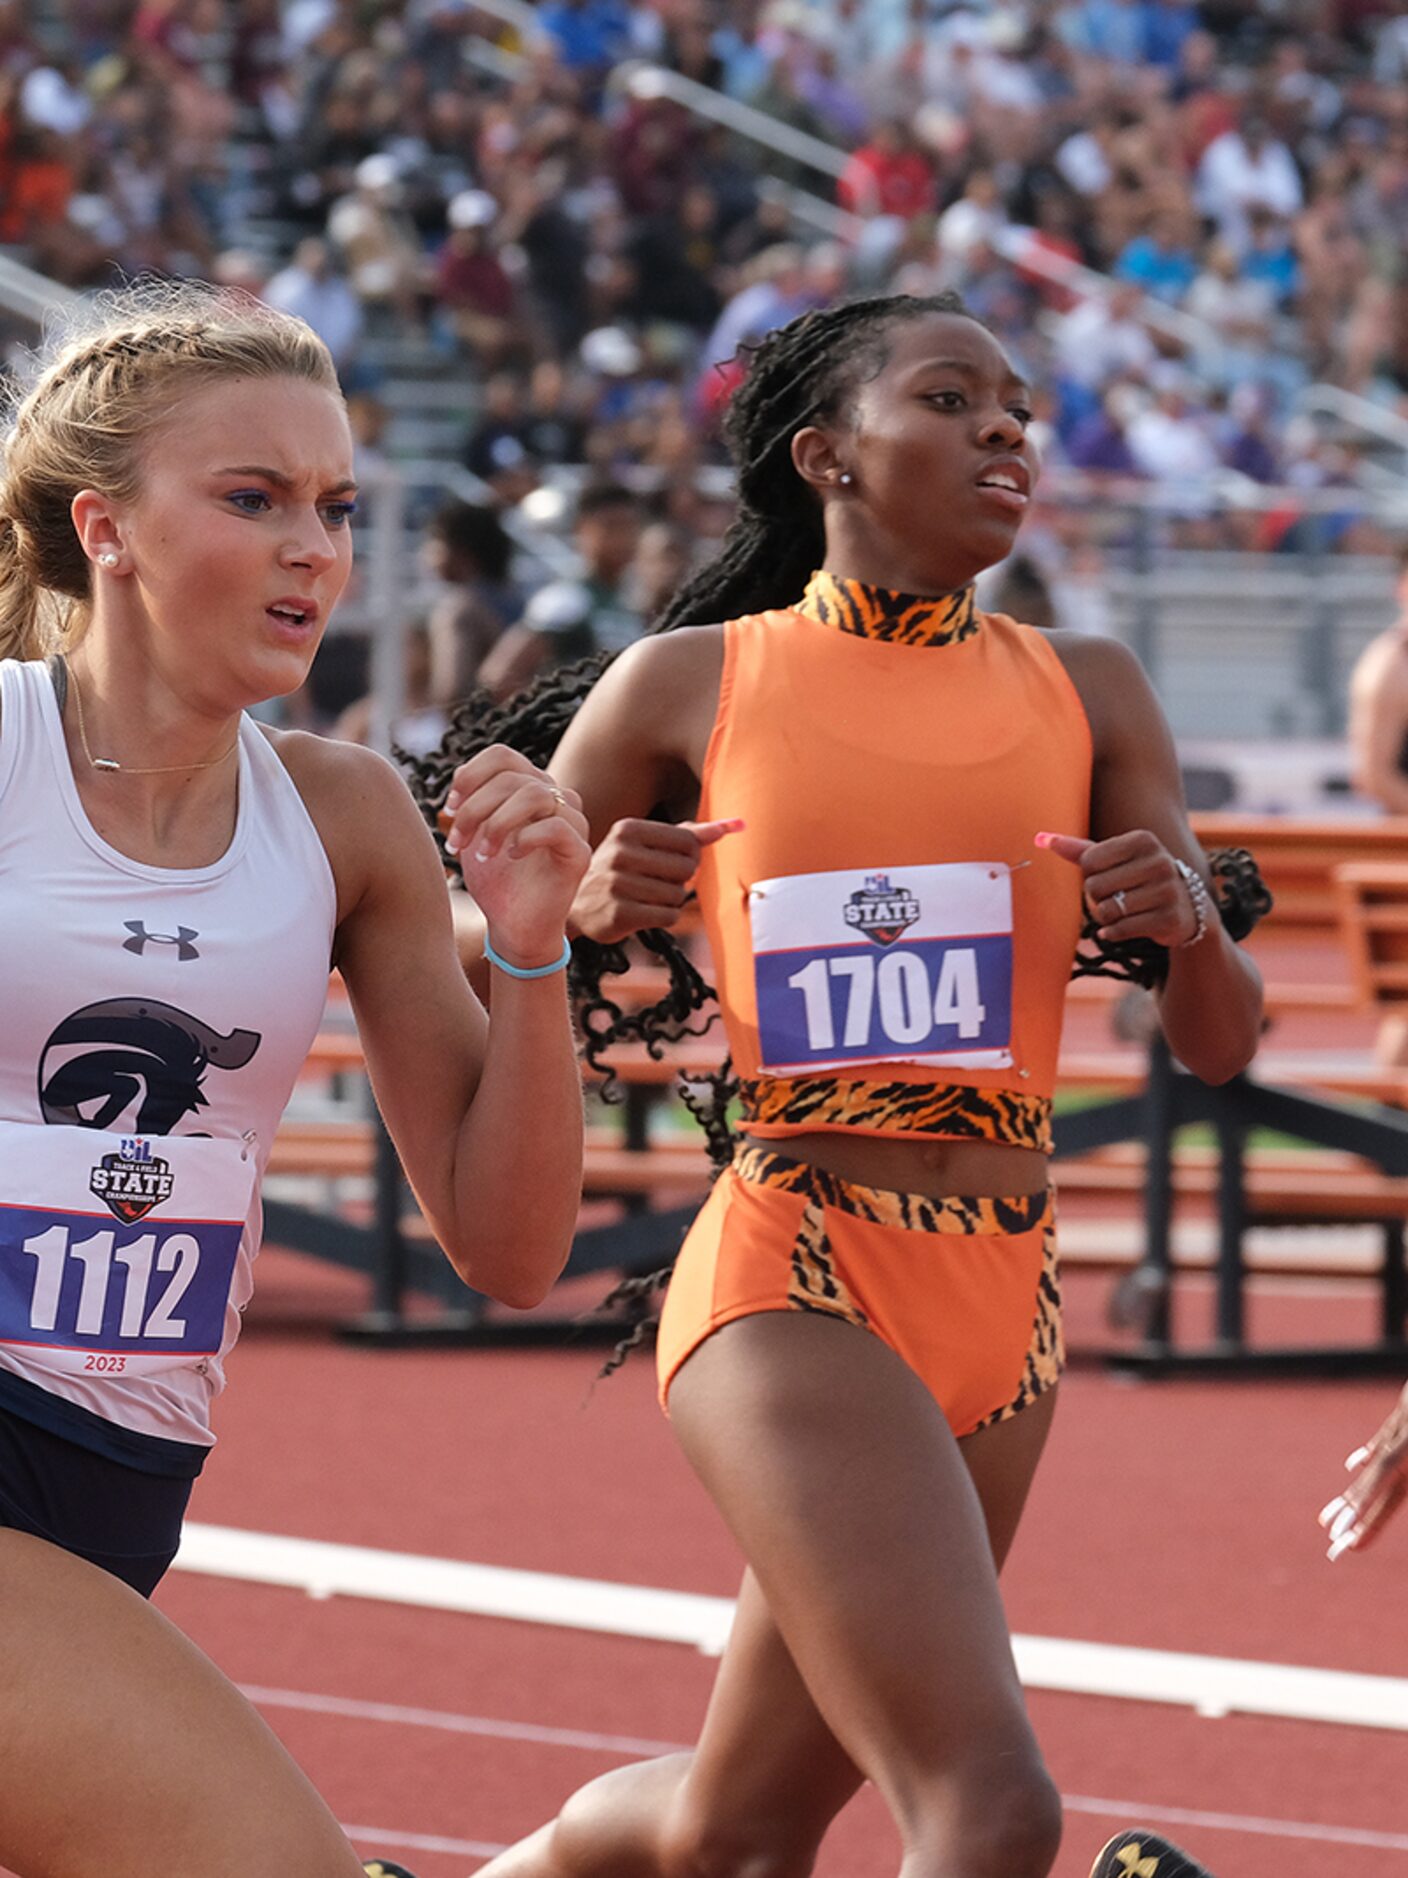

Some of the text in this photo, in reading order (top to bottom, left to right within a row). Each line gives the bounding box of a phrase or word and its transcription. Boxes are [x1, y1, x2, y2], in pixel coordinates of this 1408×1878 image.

[845, 901, 919, 924] STATE
[788, 947, 986, 1051] 1704
[91, 1168, 173, 1196] STATE
[22, 1225, 200, 1339] 1112
[84, 1355, 127, 1372] 2023
